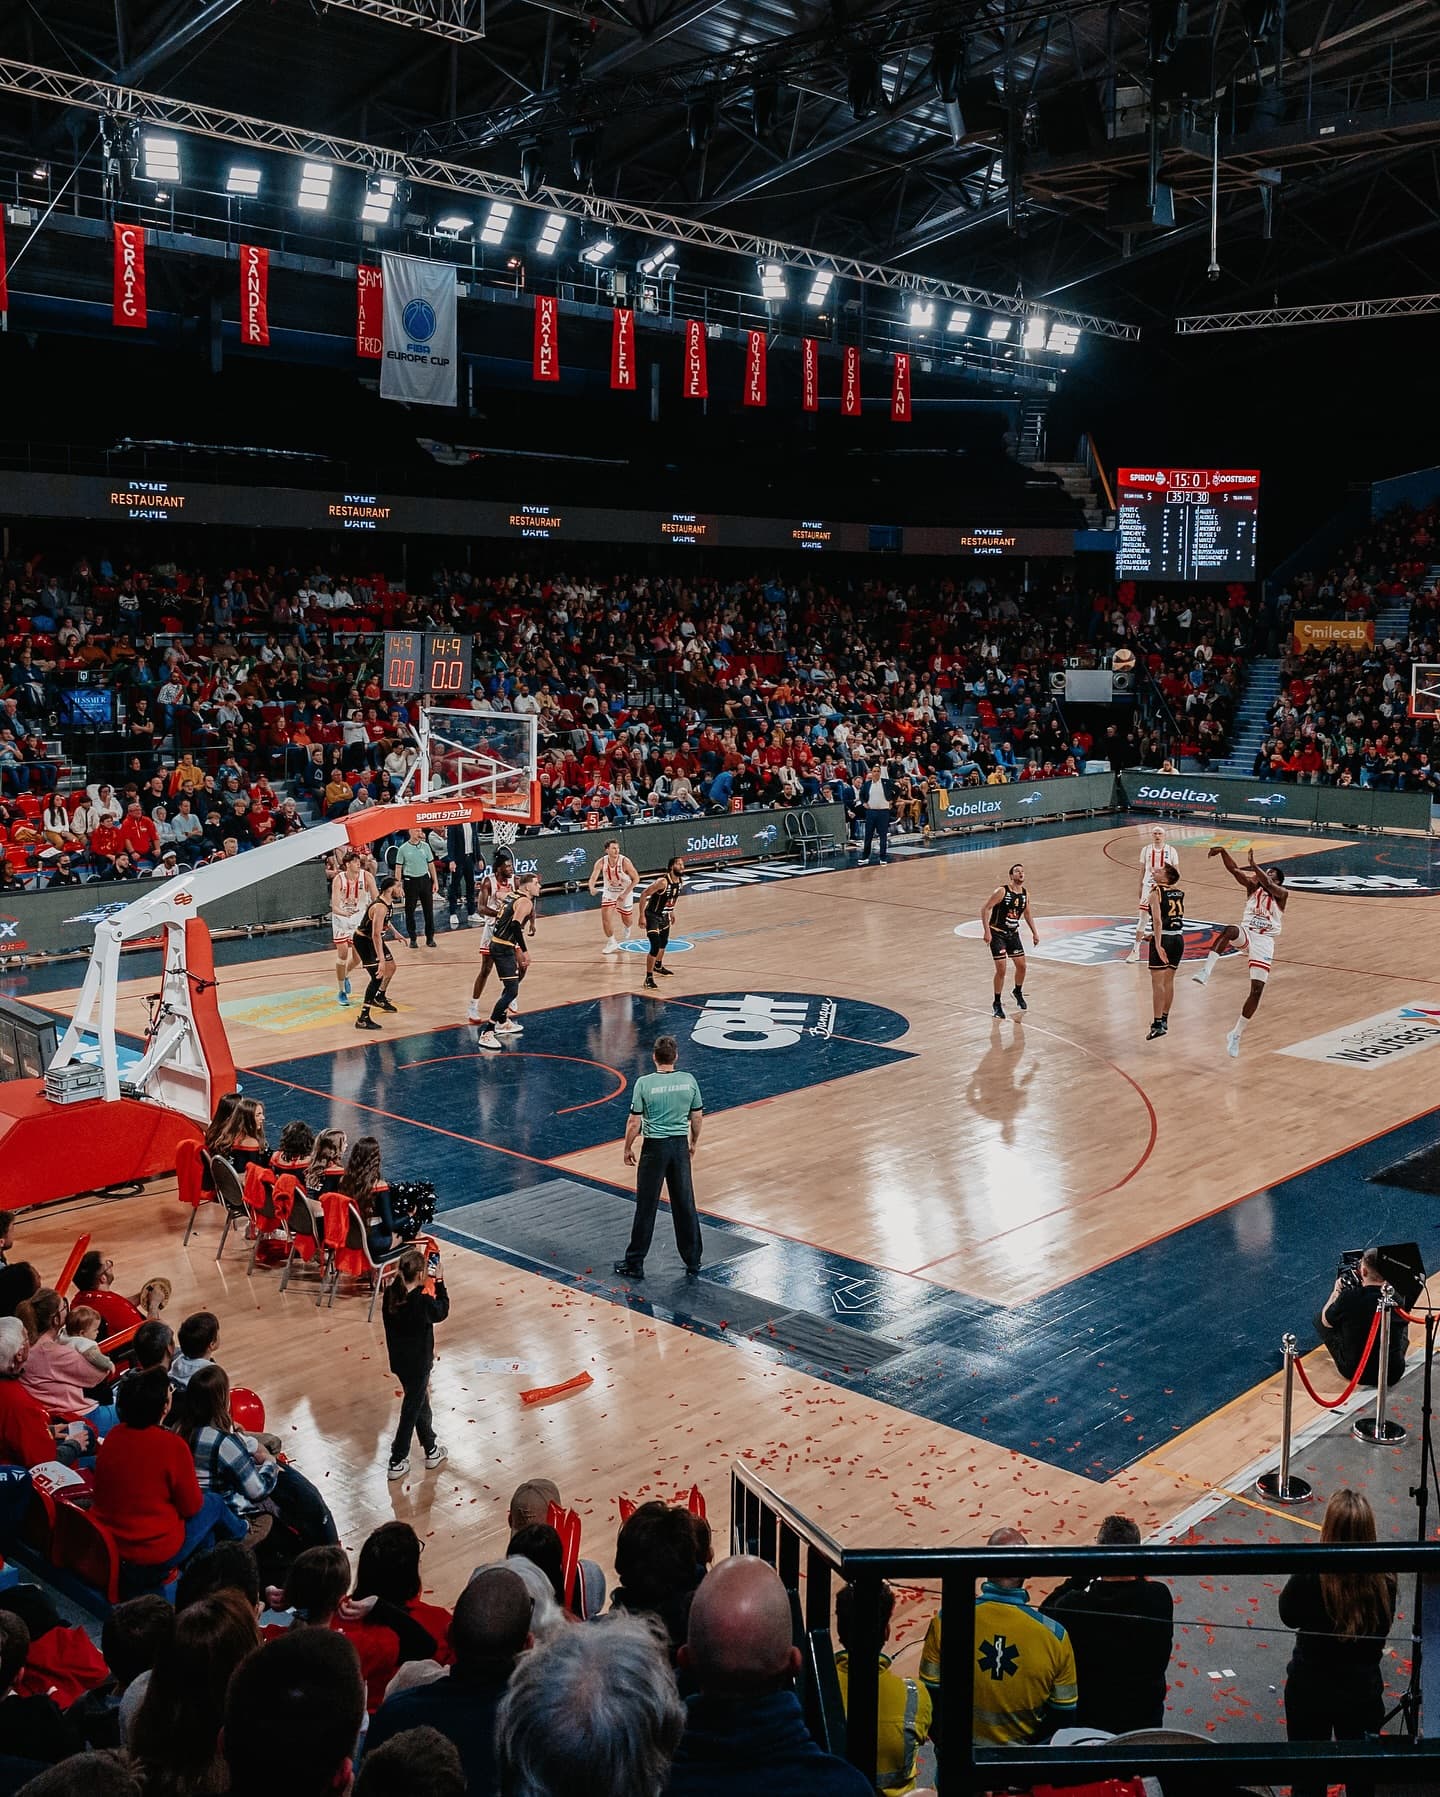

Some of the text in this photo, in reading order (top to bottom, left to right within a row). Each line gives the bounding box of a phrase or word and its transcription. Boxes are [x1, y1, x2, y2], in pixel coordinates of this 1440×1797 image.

[121, 231, 137, 318] CRAIG
[357, 268, 383, 288] SAM
[247, 247, 261, 342] SANDER
[358, 335, 383, 354] FRED
[540, 298, 552, 376] MAXIME
[406, 343, 432, 354] FIBA
[618, 310, 630, 385] WILLEM
[386, 350, 451, 367] EUROPE CUP
[690, 322, 700, 396] ARCHIE
[845, 346, 855, 412] GUSTAV
[895, 355, 906, 415] MILAN
[110, 492, 185, 508] RESTAURANT
[1171, 492, 1183, 502] 35
[328, 504, 391, 519] RESTAURANT
[508, 514, 562, 528] RESTAURANT
[660, 522, 707, 535] RESTAURANT
[792, 529, 832, 542] RESTAURANT
[960, 536, 1016, 548] RESTAURANT
[1303, 624, 1366, 640] Smilecab
[1137, 785, 1221, 803] Sobeltax
[733, 799, 741, 810] 5
[946, 799, 1003, 818] Sobeltax
[590, 814, 598, 826] 5
[686, 830, 740, 853] Sobeltax
[1167, 900, 1184, 916] 21
[1325, 1026, 1440, 1063] Wauters
